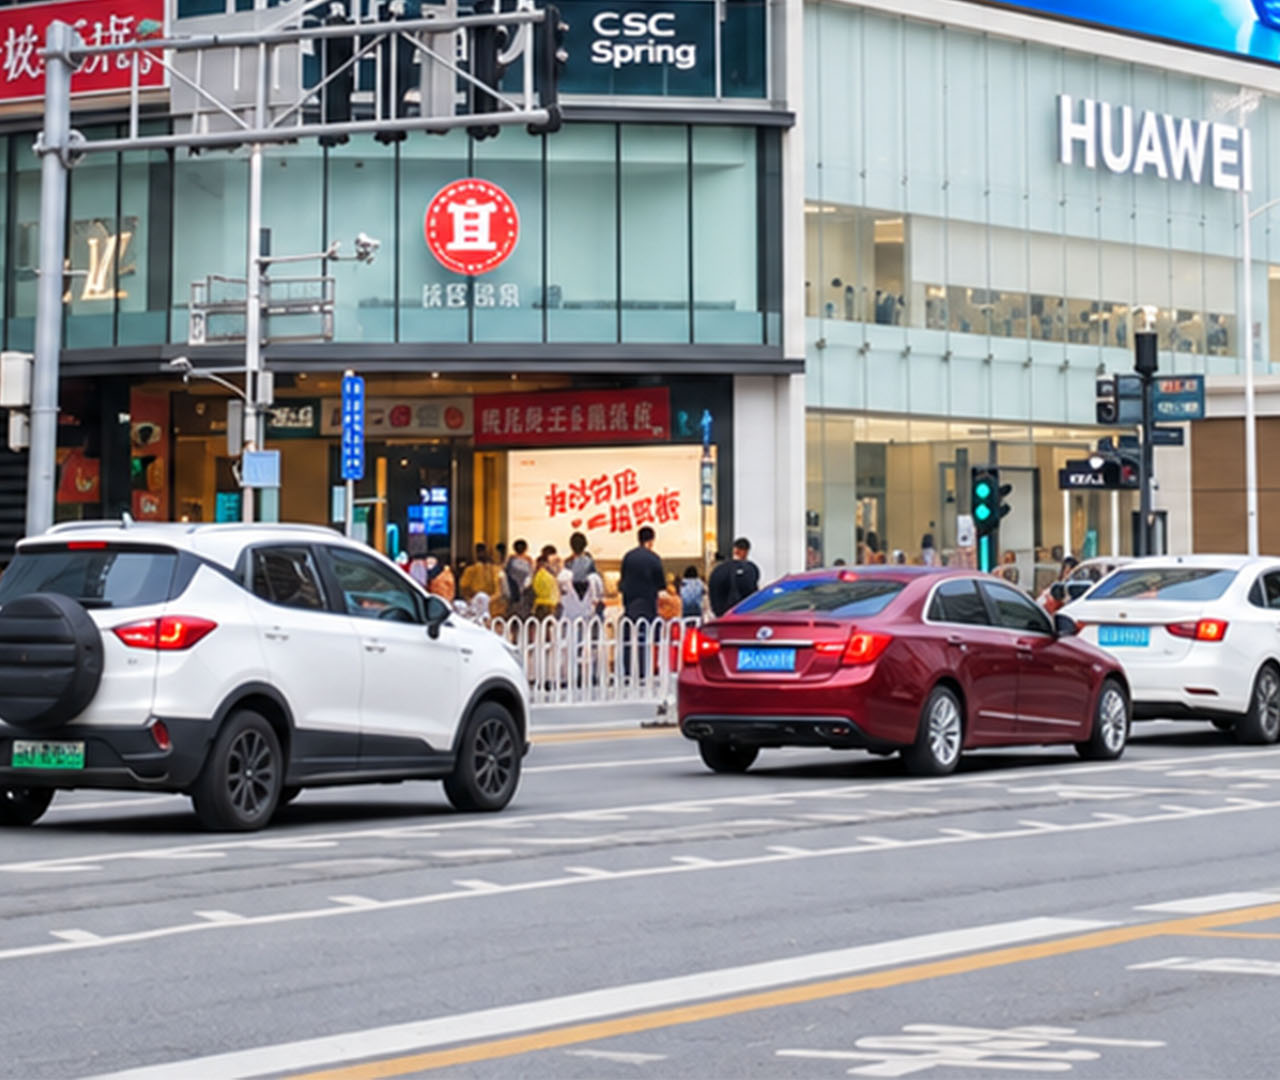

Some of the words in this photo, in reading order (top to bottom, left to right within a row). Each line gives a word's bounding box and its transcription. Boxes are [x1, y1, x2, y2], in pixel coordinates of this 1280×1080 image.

[593, 12, 675, 37] CSC
[591, 39, 696, 69] Spring
[1058, 94, 1252, 191] HUAWEI
